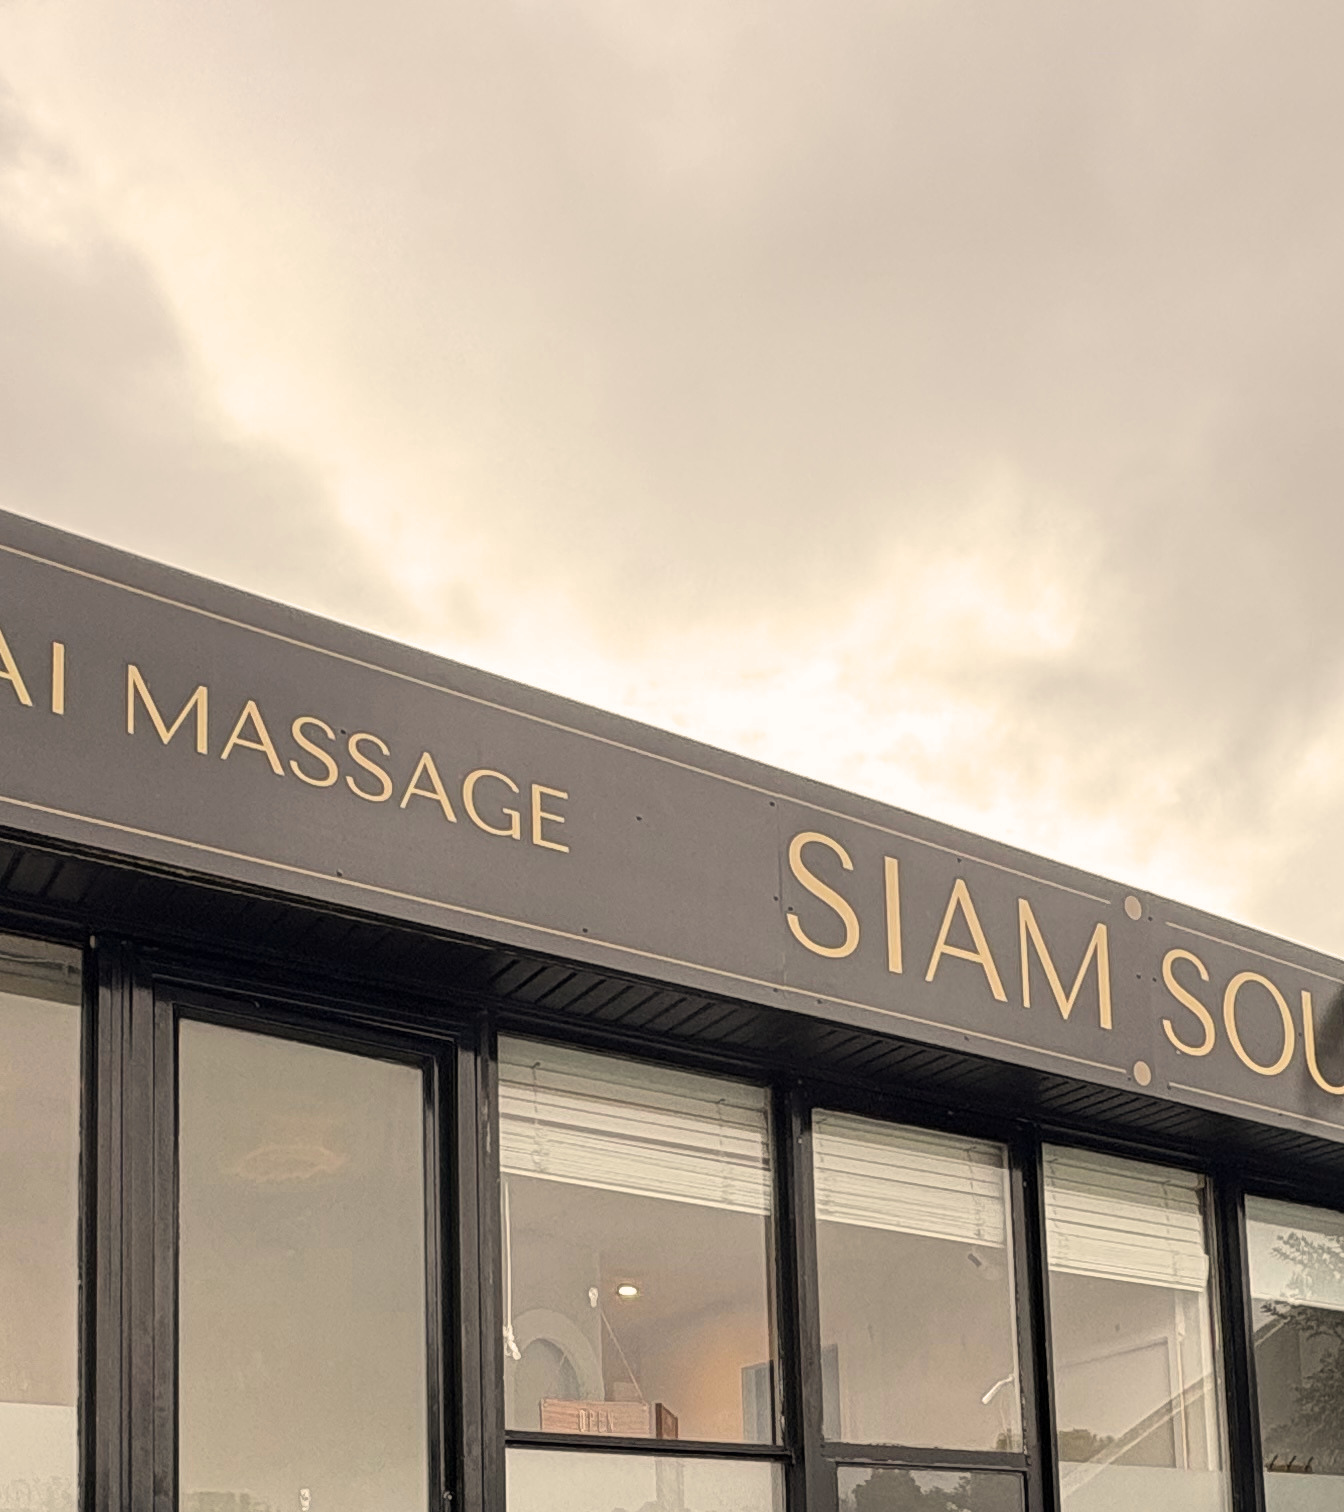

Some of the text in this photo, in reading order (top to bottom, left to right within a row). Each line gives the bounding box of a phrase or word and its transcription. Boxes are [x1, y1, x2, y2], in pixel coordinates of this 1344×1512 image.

[125, 663, 570, 854] MASSAGE
[785, 831, 1113, 1031] SIAM
[578, 1409, 614, 1433] OPEN
